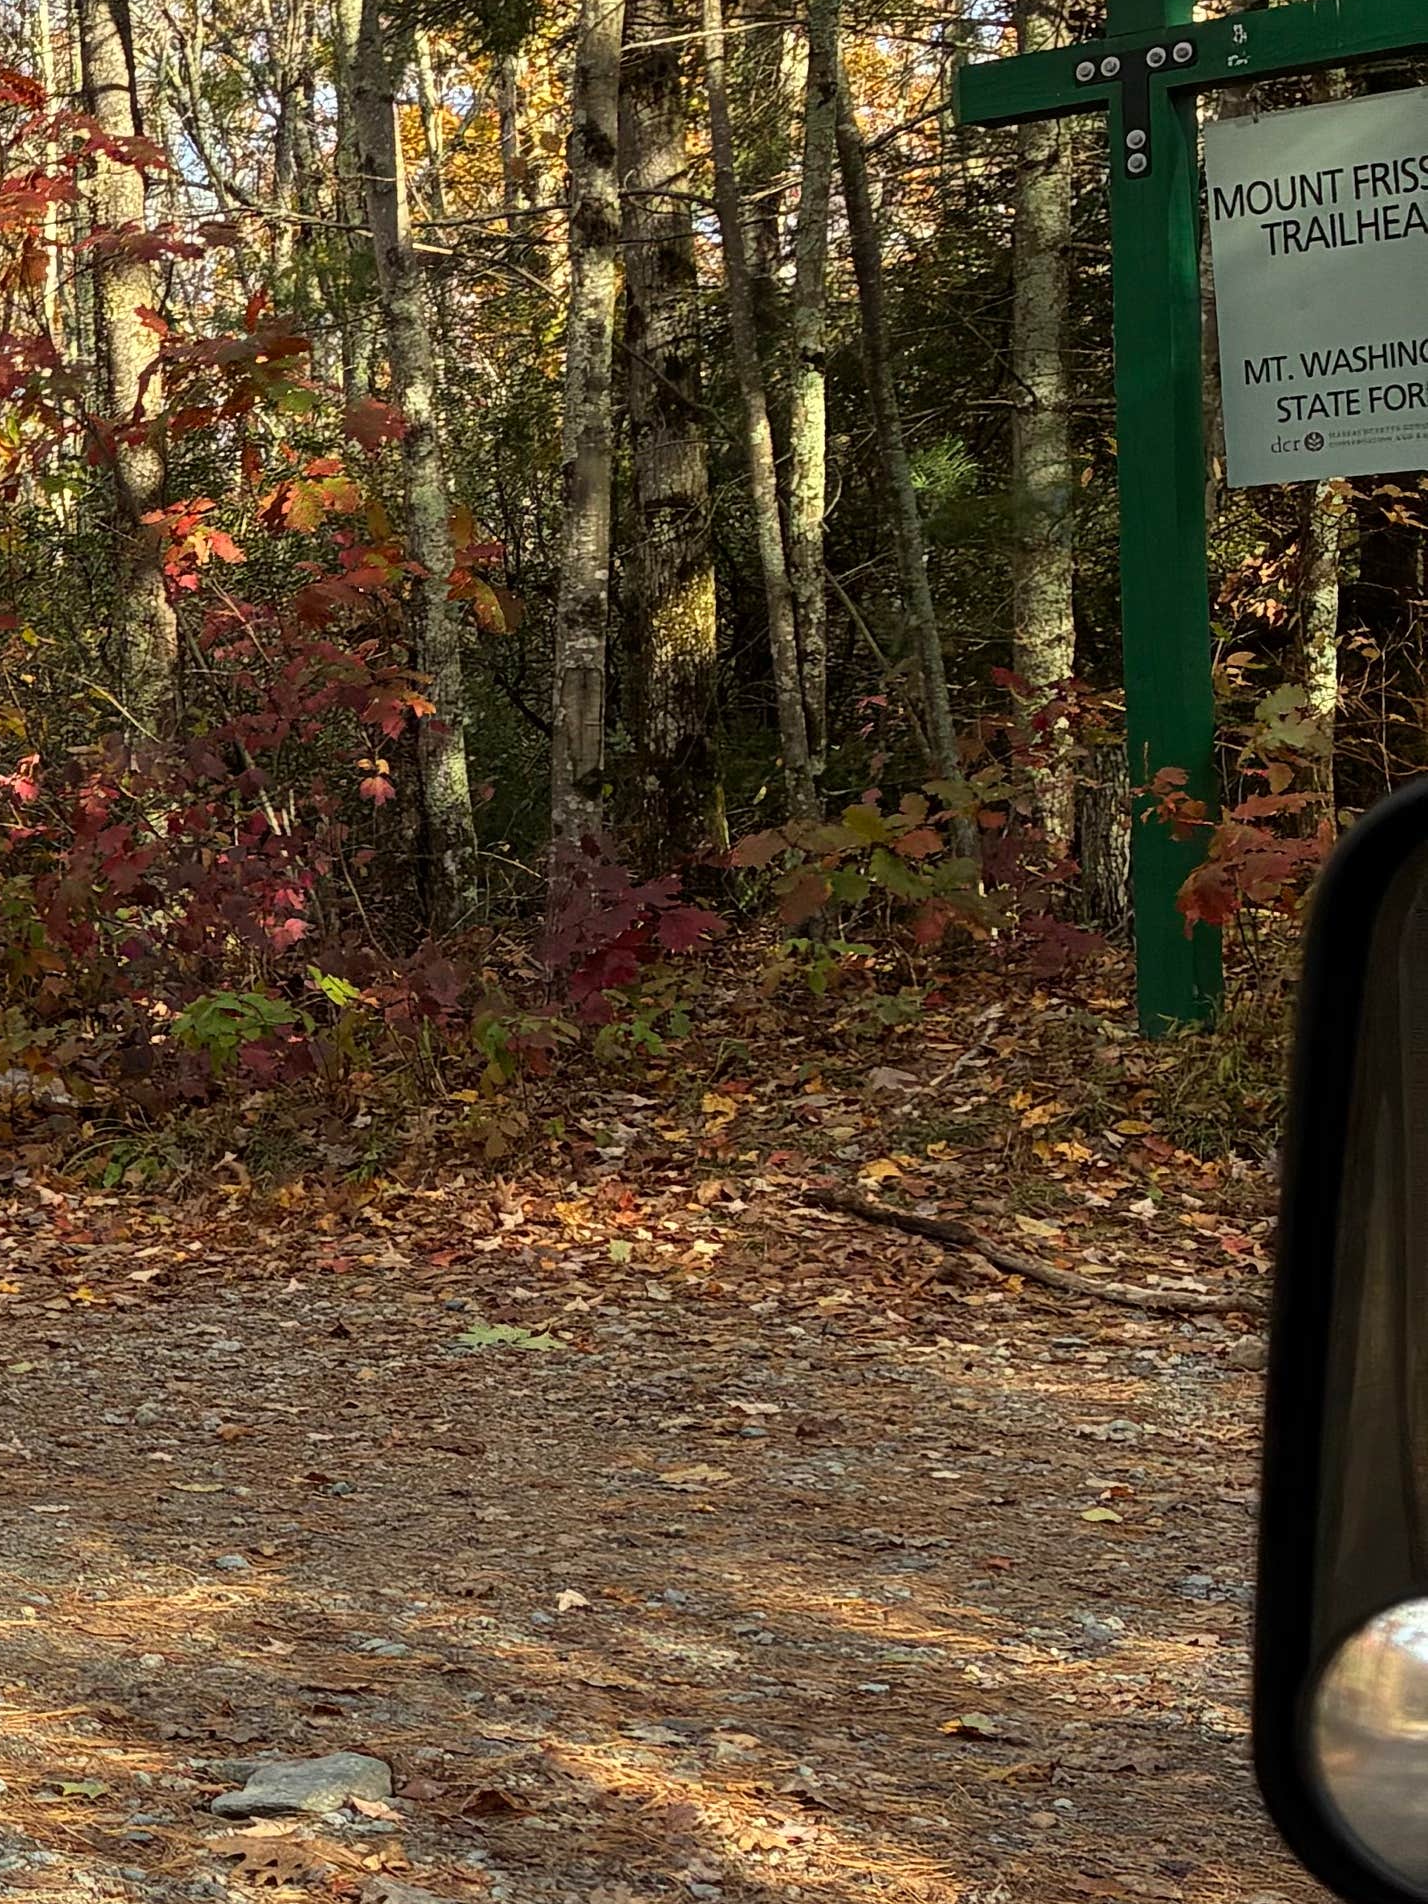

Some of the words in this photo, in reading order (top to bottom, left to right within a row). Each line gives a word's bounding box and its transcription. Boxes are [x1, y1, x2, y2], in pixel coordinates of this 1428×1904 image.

[1213, 168, 1344, 221] MOUNT
[1260, 201, 1428, 256] TRAILHEA
[1244, 355, 1294, 385] MT.
[1276, 388, 1361, 424] STATE
[1368, 381, 1428, 413] FOR
[1271, 435, 1301, 454] dcr
